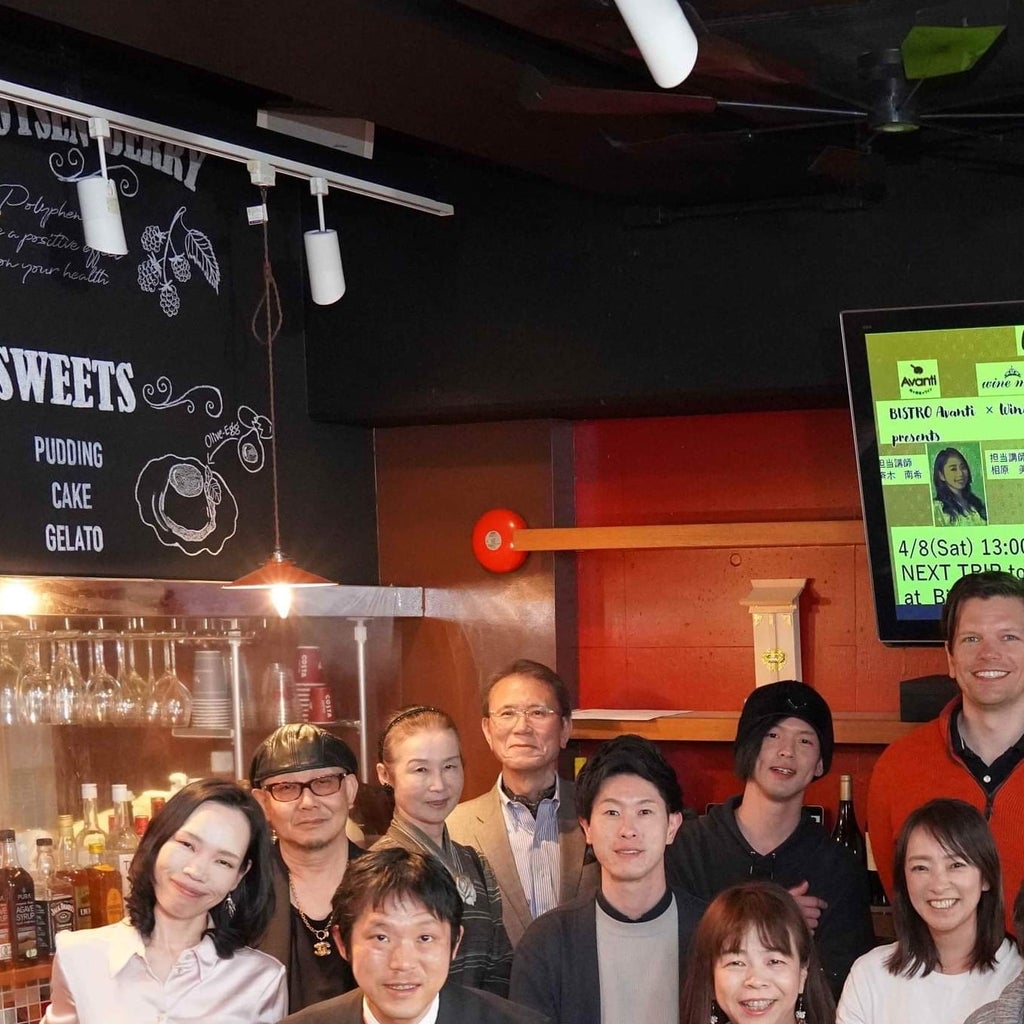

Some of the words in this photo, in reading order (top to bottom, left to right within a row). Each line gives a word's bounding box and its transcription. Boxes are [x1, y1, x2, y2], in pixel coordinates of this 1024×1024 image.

[0, 184, 84, 228] Polyphen
[16, 233, 80, 254] positive
[21, 264, 60, 285] your
[63, 262, 109, 285] health
[0, 346, 137, 413] SWEETS
[901, 374, 937, 388] Avanti
[981, 377, 1011, 389] wine
[889, 405, 932, 420] BISTRO
[936, 404, 976, 418] Avanti
[204, 421, 241, 448] Olive-Egg
[891, 429, 941, 447] presents
[34, 436, 104, 468] PUDDING
[51, 481, 93, 510] CAKE
[45, 523, 104, 552] GELATO
[899, 537, 973, 559] 4/8(Sat)
[901, 564, 951, 582] NEXT
[904, 590, 921, 606] at
[16, 904, 35, 913] AGAVE
[16, 912, 36, 922] SYRUP
